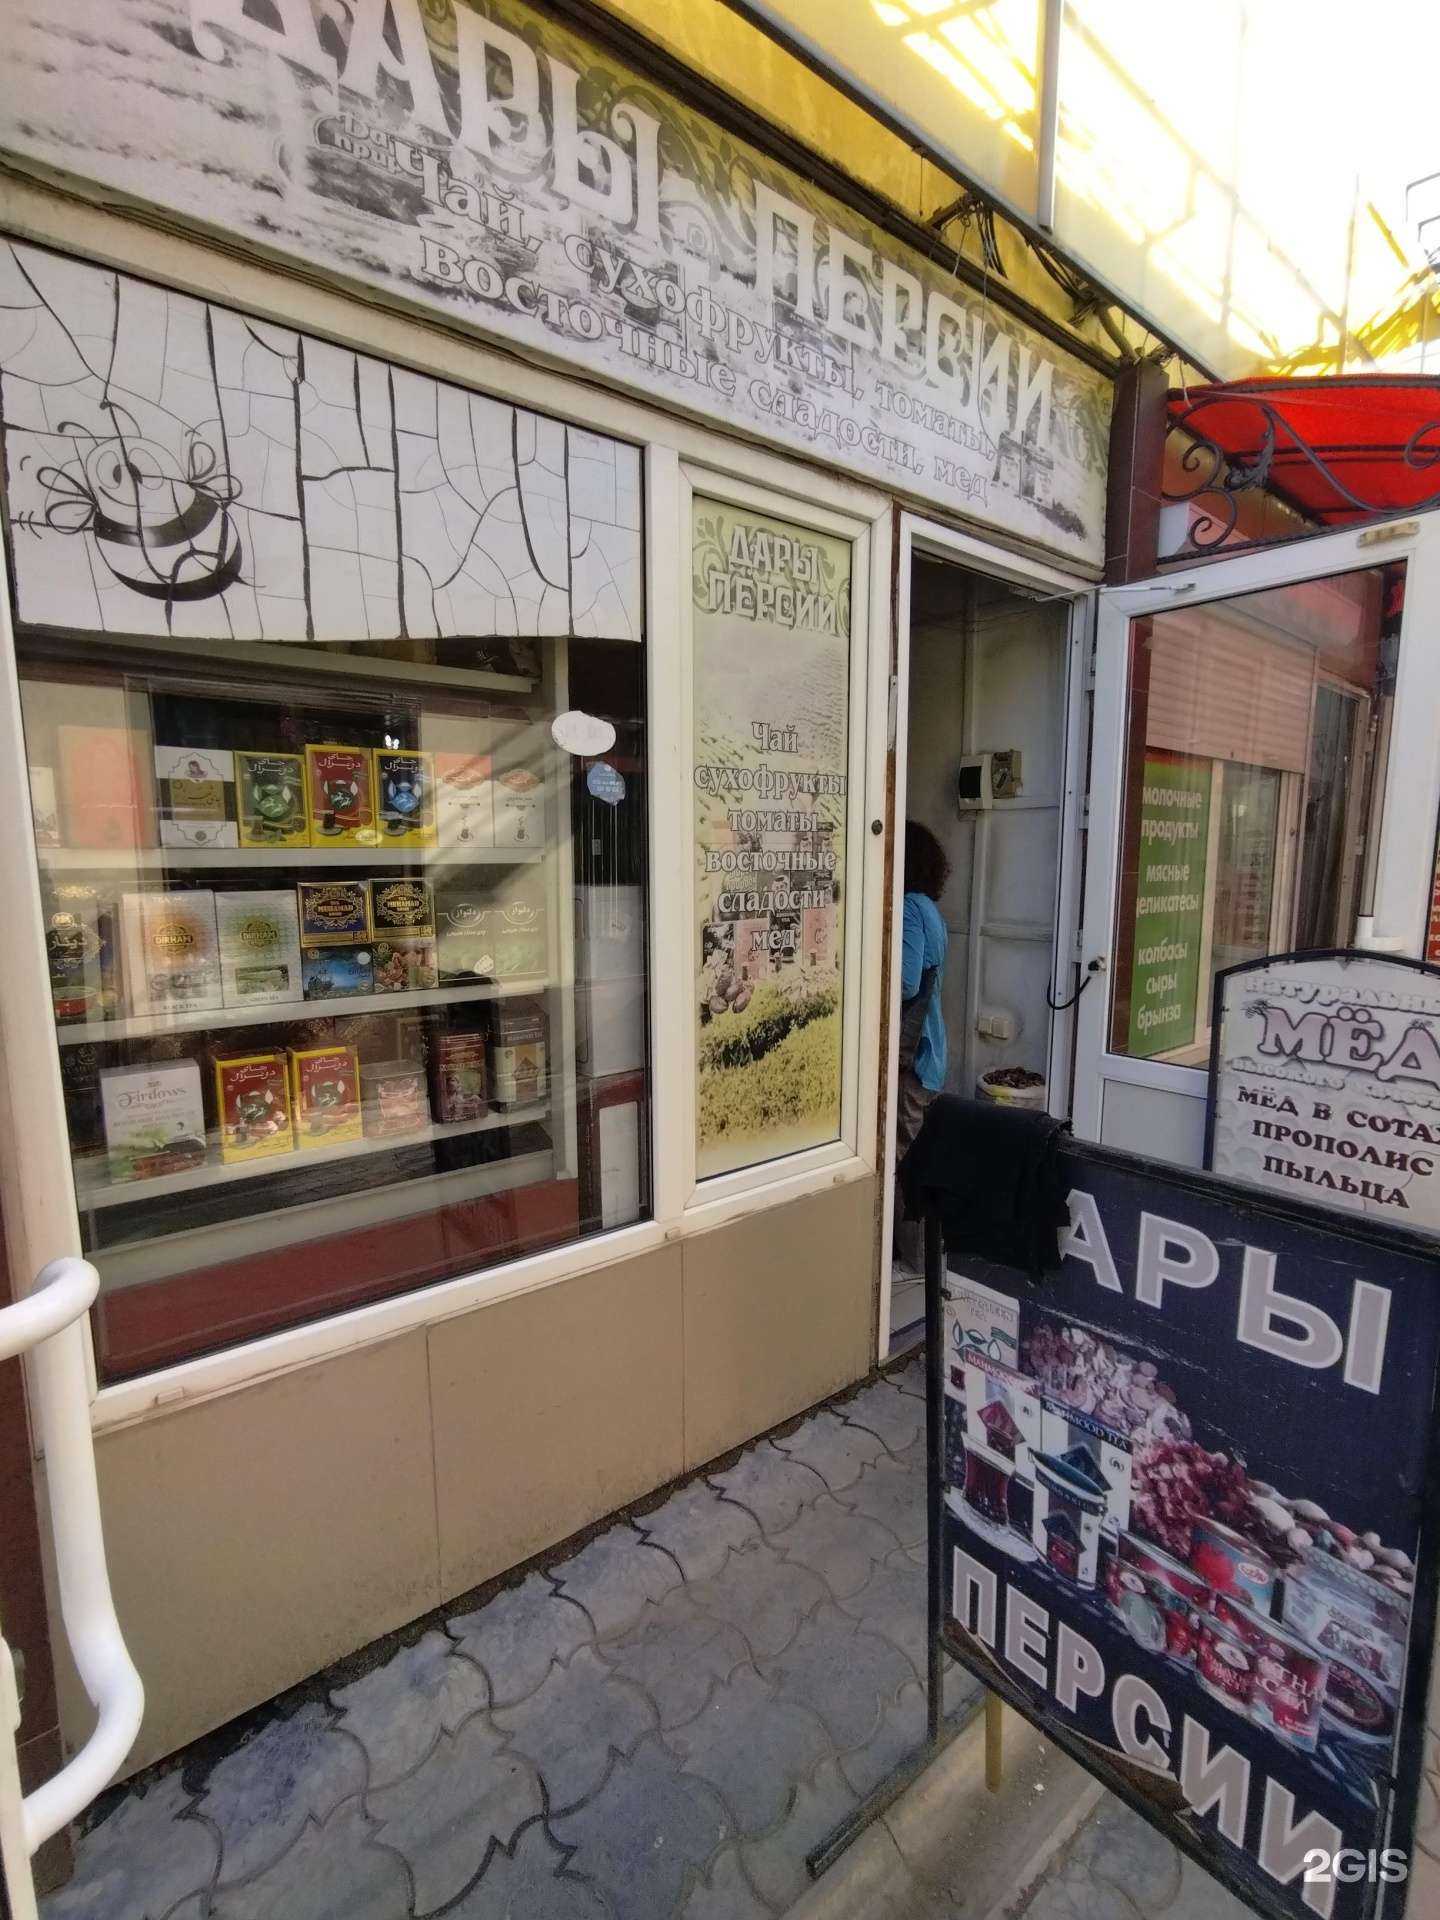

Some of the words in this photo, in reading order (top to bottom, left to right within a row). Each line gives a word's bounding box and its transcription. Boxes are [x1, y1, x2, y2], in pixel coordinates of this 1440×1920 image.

[752, 178, 1054, 452] ПЕРСИИ
[564, 234, 864, 400] сухофрукты,
[876, 380, 996, 460] томаты,
[749, 379, 924, 475] сладости,
[933, 456, 988, 508] мед
[729, 525, 819, 584] ДАРЫ
[708, 570, 838, 636] ПЕРСИИ
[752, 721, 798, 752] Чай
[693, 764, 847, 800] сухофрукты
[1142, 786, 1202, 809] молочные
[728, 809, 818, 832] томаты
[1140, 820, 1198, 844] продукты
[705, 850, 836, 872] восточные
[1146, 864, 1190, 882] мясные
[718, 890, 826, 915] сладости
[751, 930, 797, 950] мед
[1138, 937, 1187, 964] колбасы
[1146, 972, 1177, 999] сыры
[1137, 1004, 1181, 1034] брынза
[1237, 1085, 1298, 1116] МЁД
[1312, 1102, 1333, 1121] В
[1252, 1120, 1434, 1177] ПРОПОЛИС
[1262, 1155, 1410, 1209] ПЫЛЬЦА
[1057, 1187, 1394, 1396] АРЫ
[952, 1544, 1342, 1920] ПЕРСИИ
